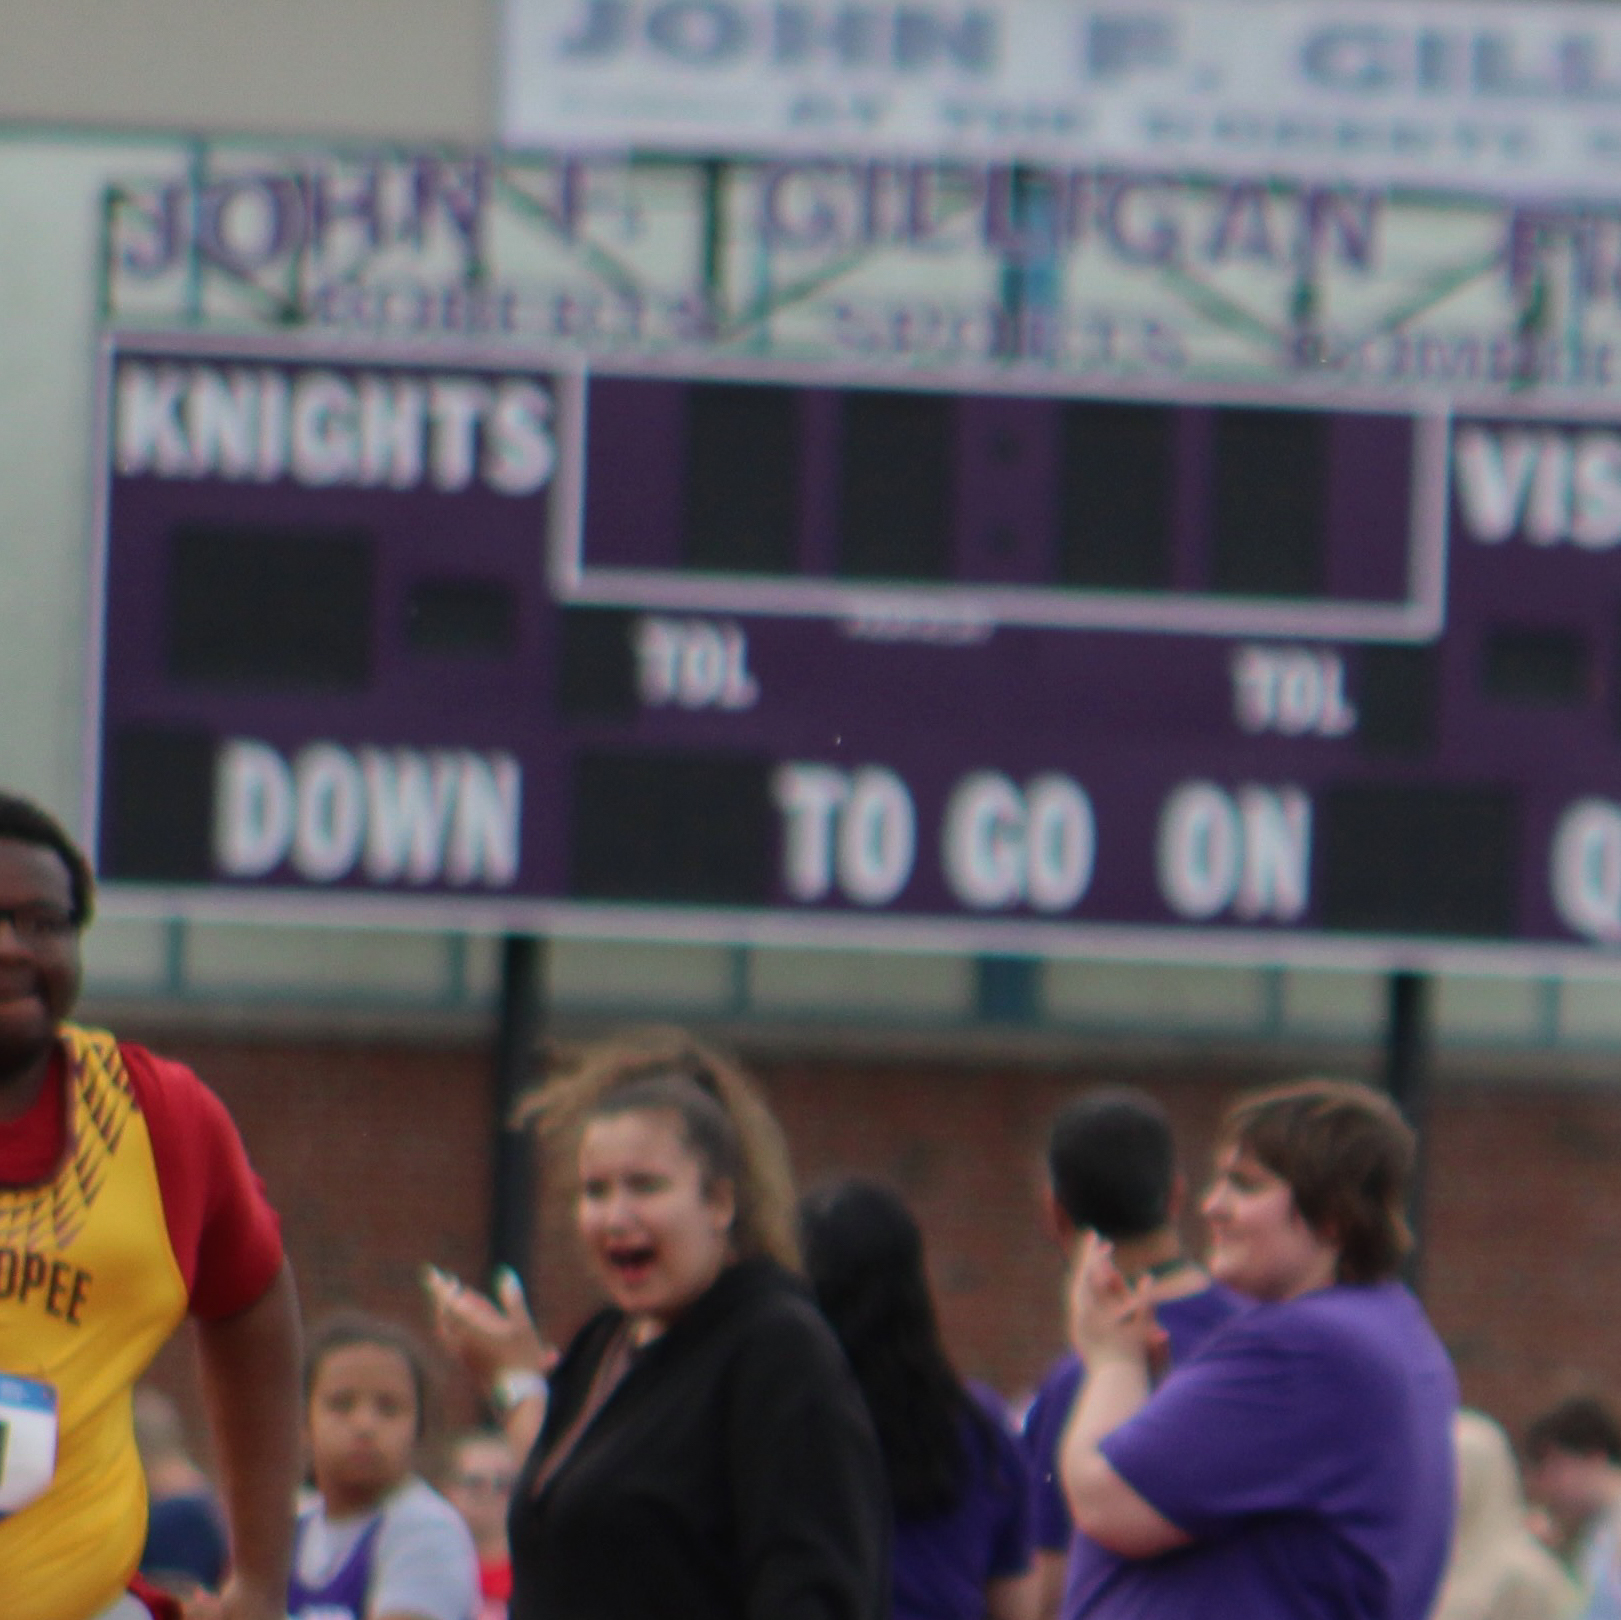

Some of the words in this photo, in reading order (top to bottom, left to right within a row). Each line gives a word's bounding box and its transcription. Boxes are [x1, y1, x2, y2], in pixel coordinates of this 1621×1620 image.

[558, 0, 996, 68] JOHN
[120, 153, 488, 280] JOHN
[115, 362, 557, 496] KNIGHTS
[637, 619, 758, 711] TOL
[1233, 645, 1356, 737] TOL
[215, 738, 522, 888] DOWN
[776, 761, 917, 906] TO
[941, 772, 1096, 913] GO
[1158, 779, 1314, 921] ON
